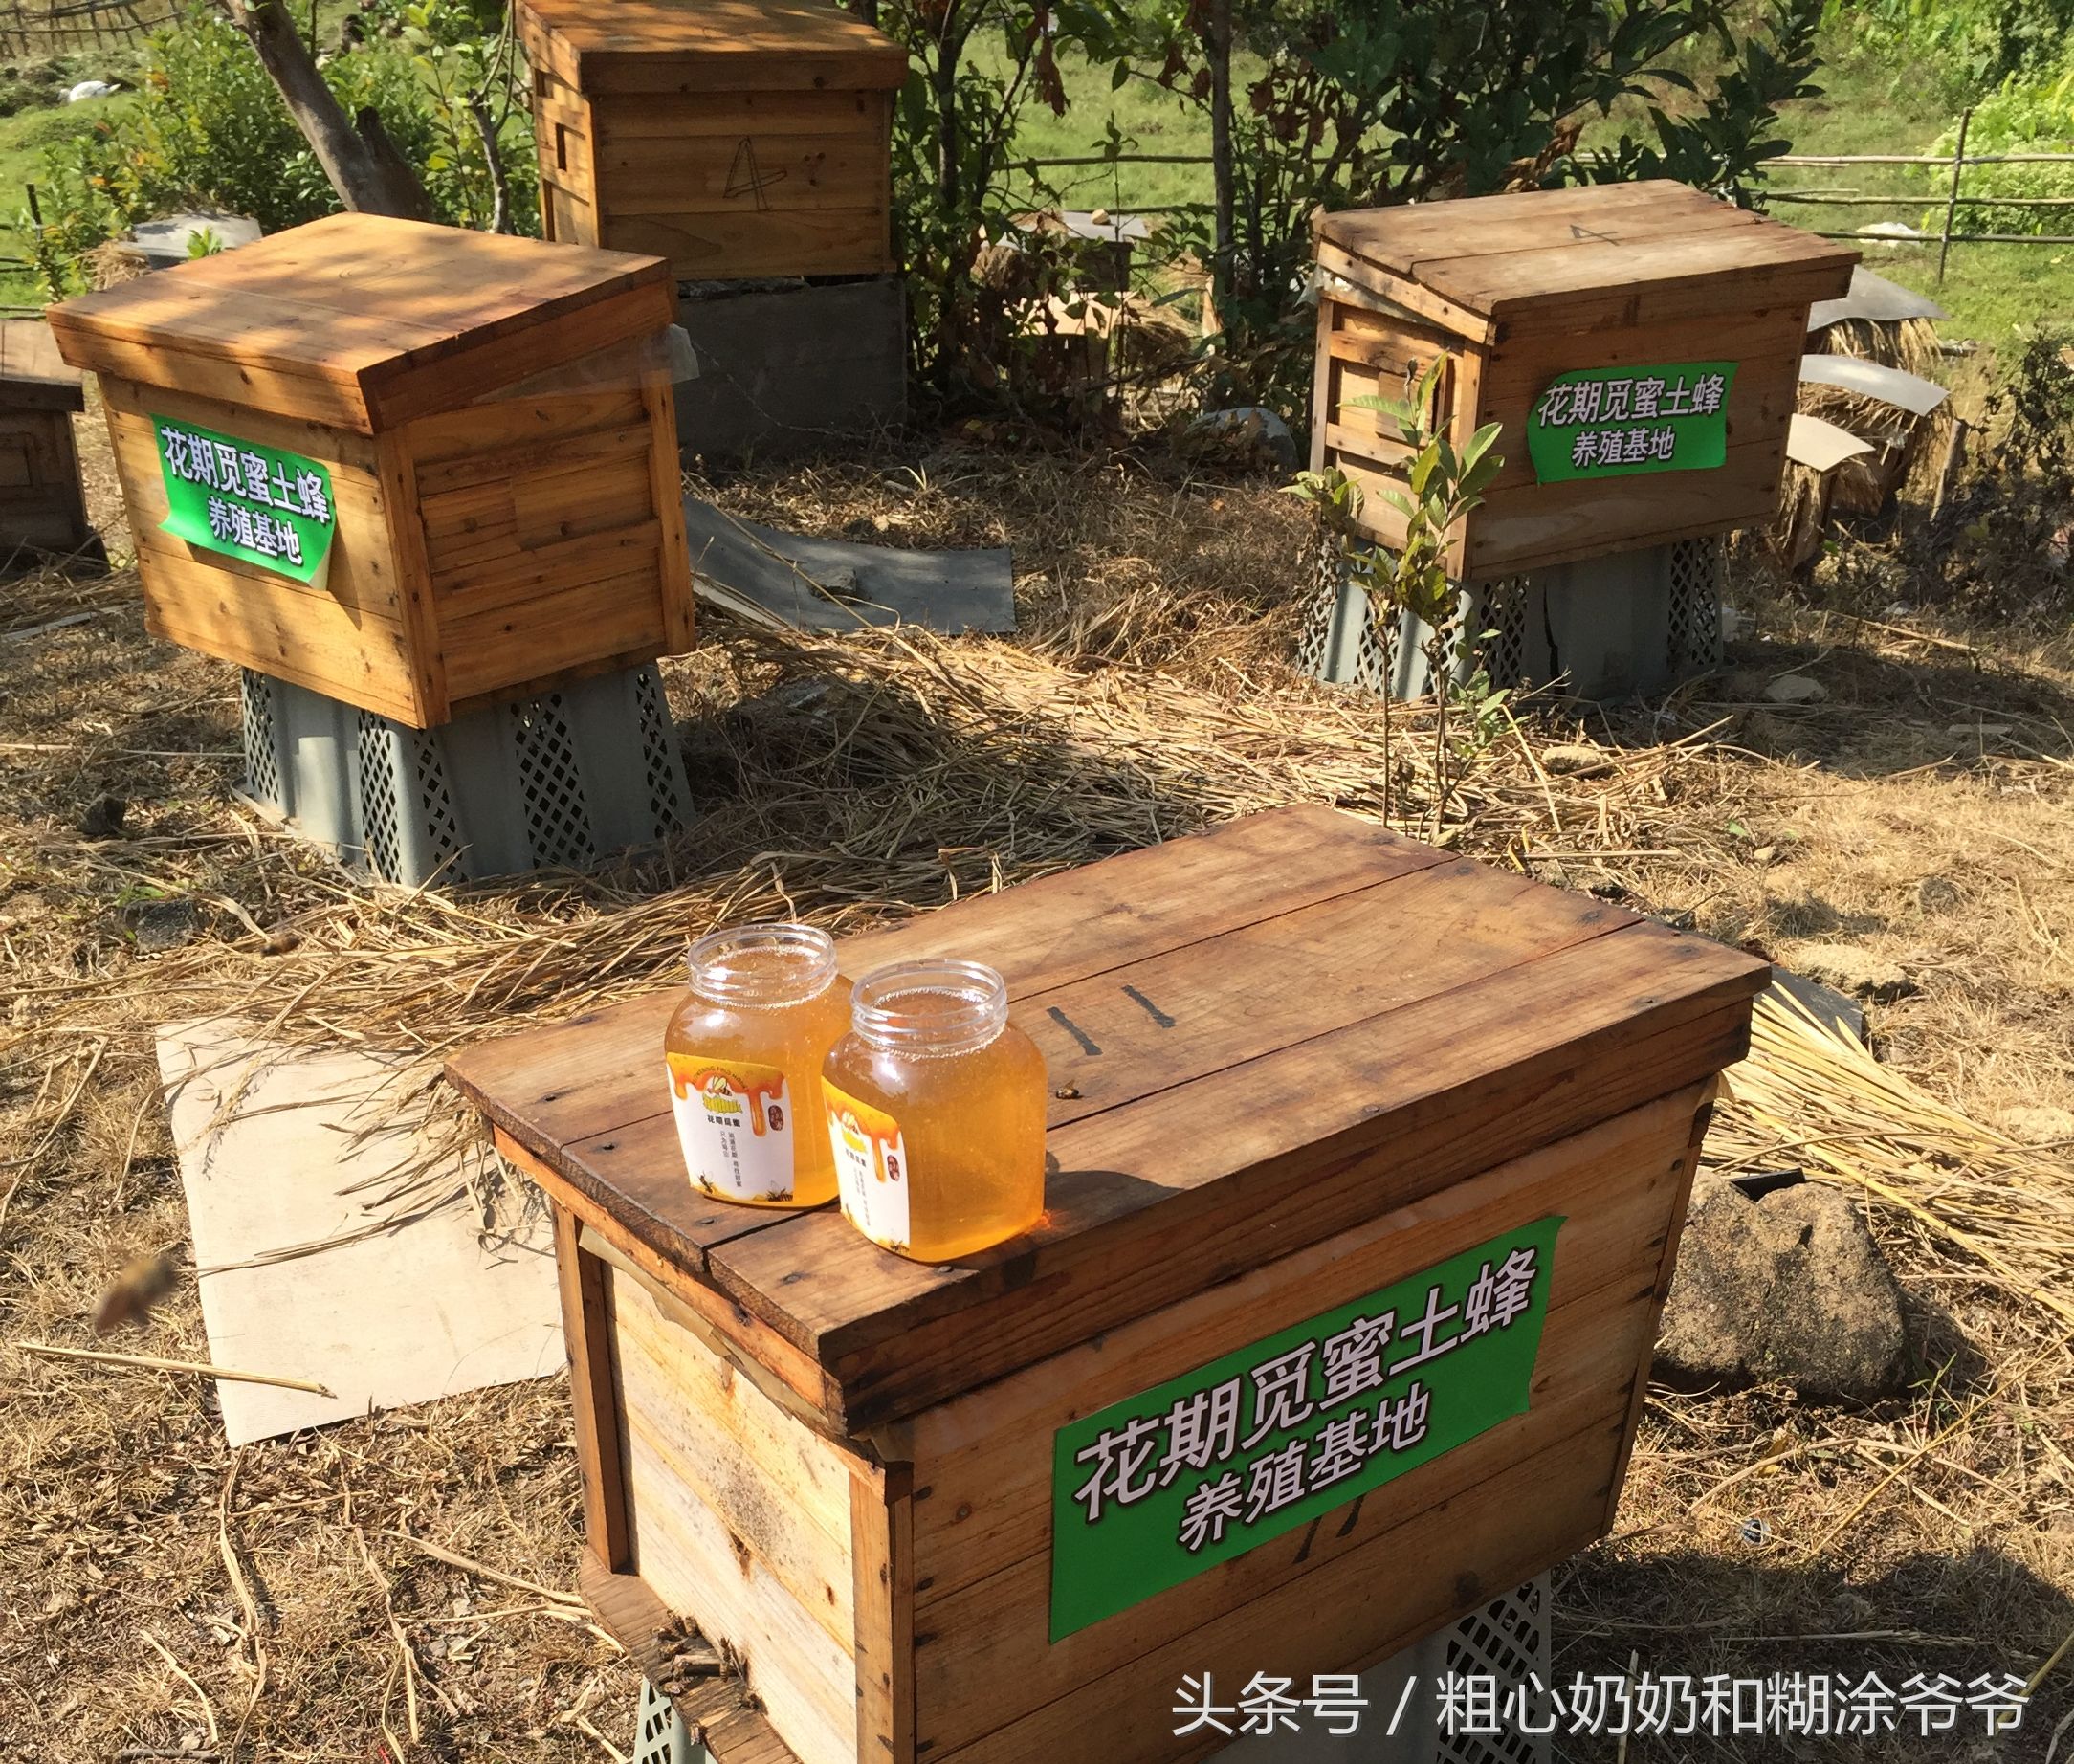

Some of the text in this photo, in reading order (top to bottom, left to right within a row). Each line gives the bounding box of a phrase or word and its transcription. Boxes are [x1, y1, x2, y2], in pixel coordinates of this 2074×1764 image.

[1537, 373, 1726, 428] 花期觅蜜土蜂
[160, 425, 332, 524] 花期觅蜜土蜂
[1571, 425, 1676, 468] 养殖基地
[208, 496, 304, 565] 养殖基地
[1073, 1247, 1538, 1522] 花期觅蜜土蜂
[1179, 1381, 1431, 1552] 养殖基地
